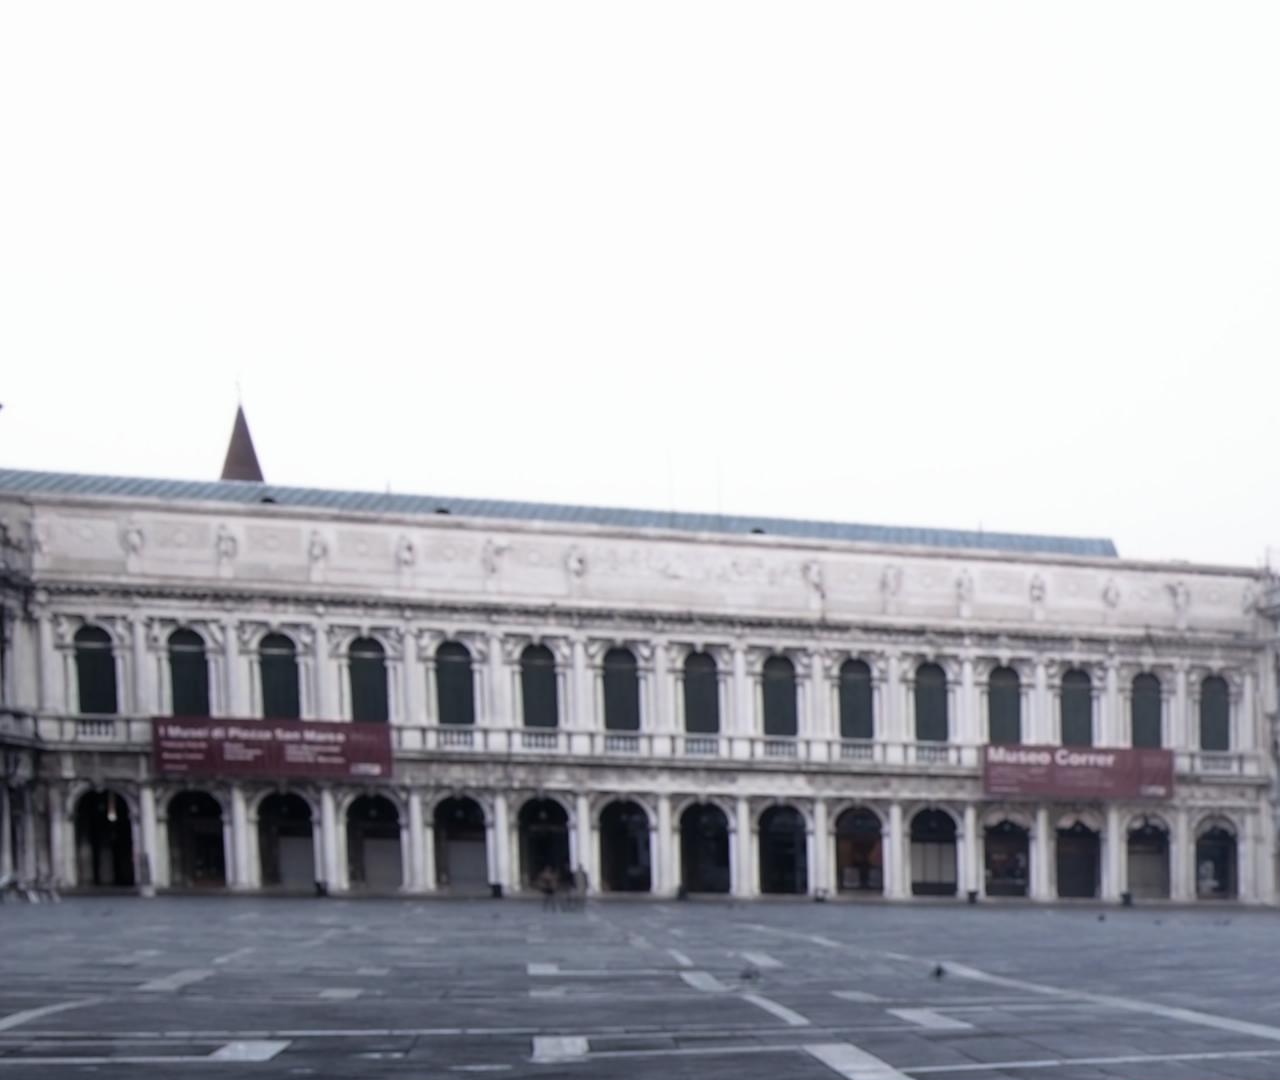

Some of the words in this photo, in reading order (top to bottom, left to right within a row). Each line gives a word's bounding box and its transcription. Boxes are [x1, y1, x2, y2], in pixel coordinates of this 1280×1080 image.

[303, 729, 347, 743] Marco
[987, 747, 1051, 765] Museo
[1054, 750, 1115, 767] Correr
